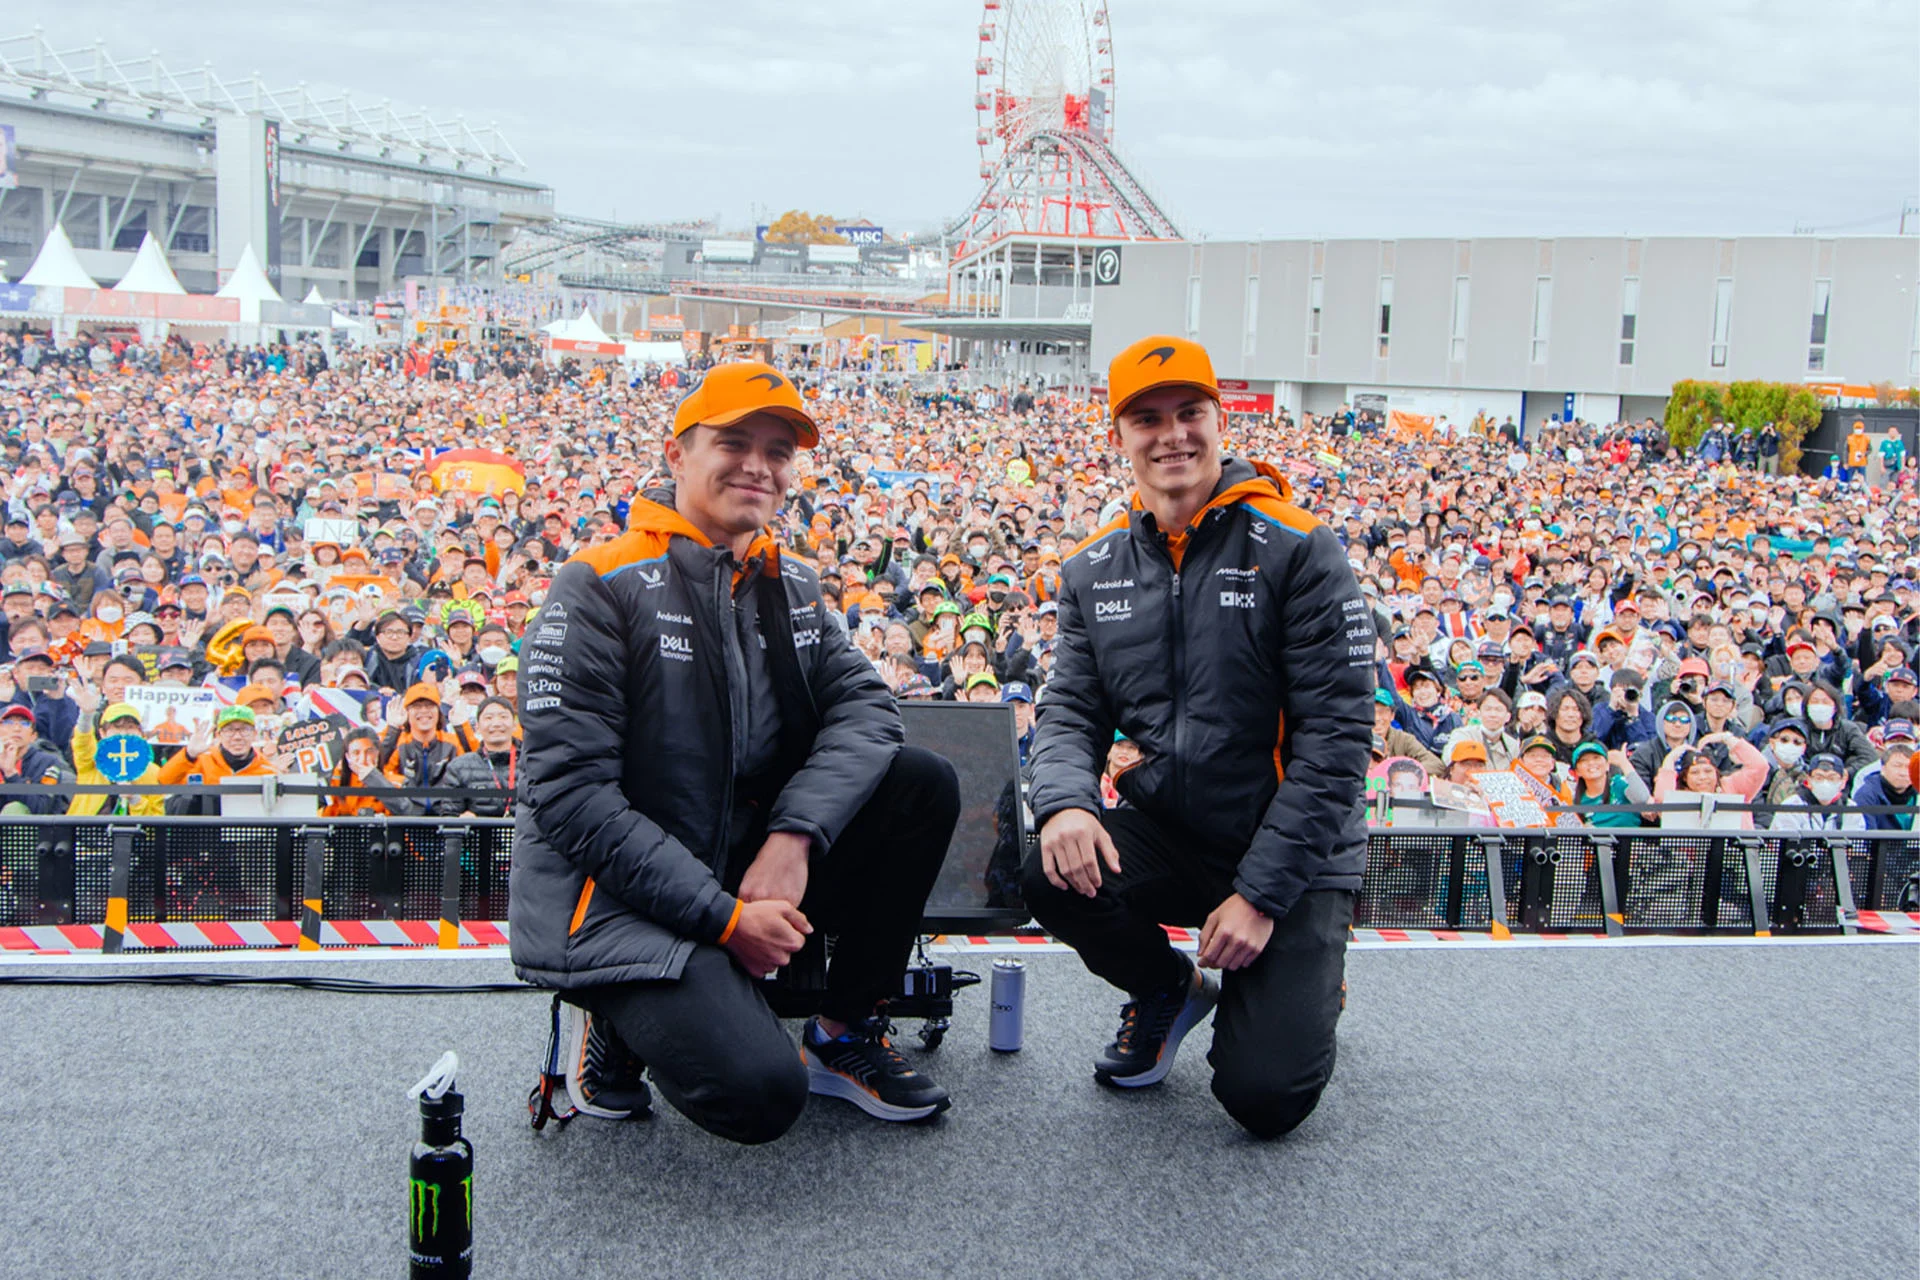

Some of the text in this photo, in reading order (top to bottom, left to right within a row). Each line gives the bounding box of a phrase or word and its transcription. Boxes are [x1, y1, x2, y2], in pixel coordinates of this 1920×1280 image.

[853, 231, 882, 243] MSC
[307, 521, 357, 540] LN4
[1092, 580, 1122, 590] Android
[1096, 599, 1132, 615] DELL
[656, 610, 682, 623] Android
[660, 633, 694, 653] DELL
[129, 687, 190, 704] Happy
[296, 743, 334, 774] P1
